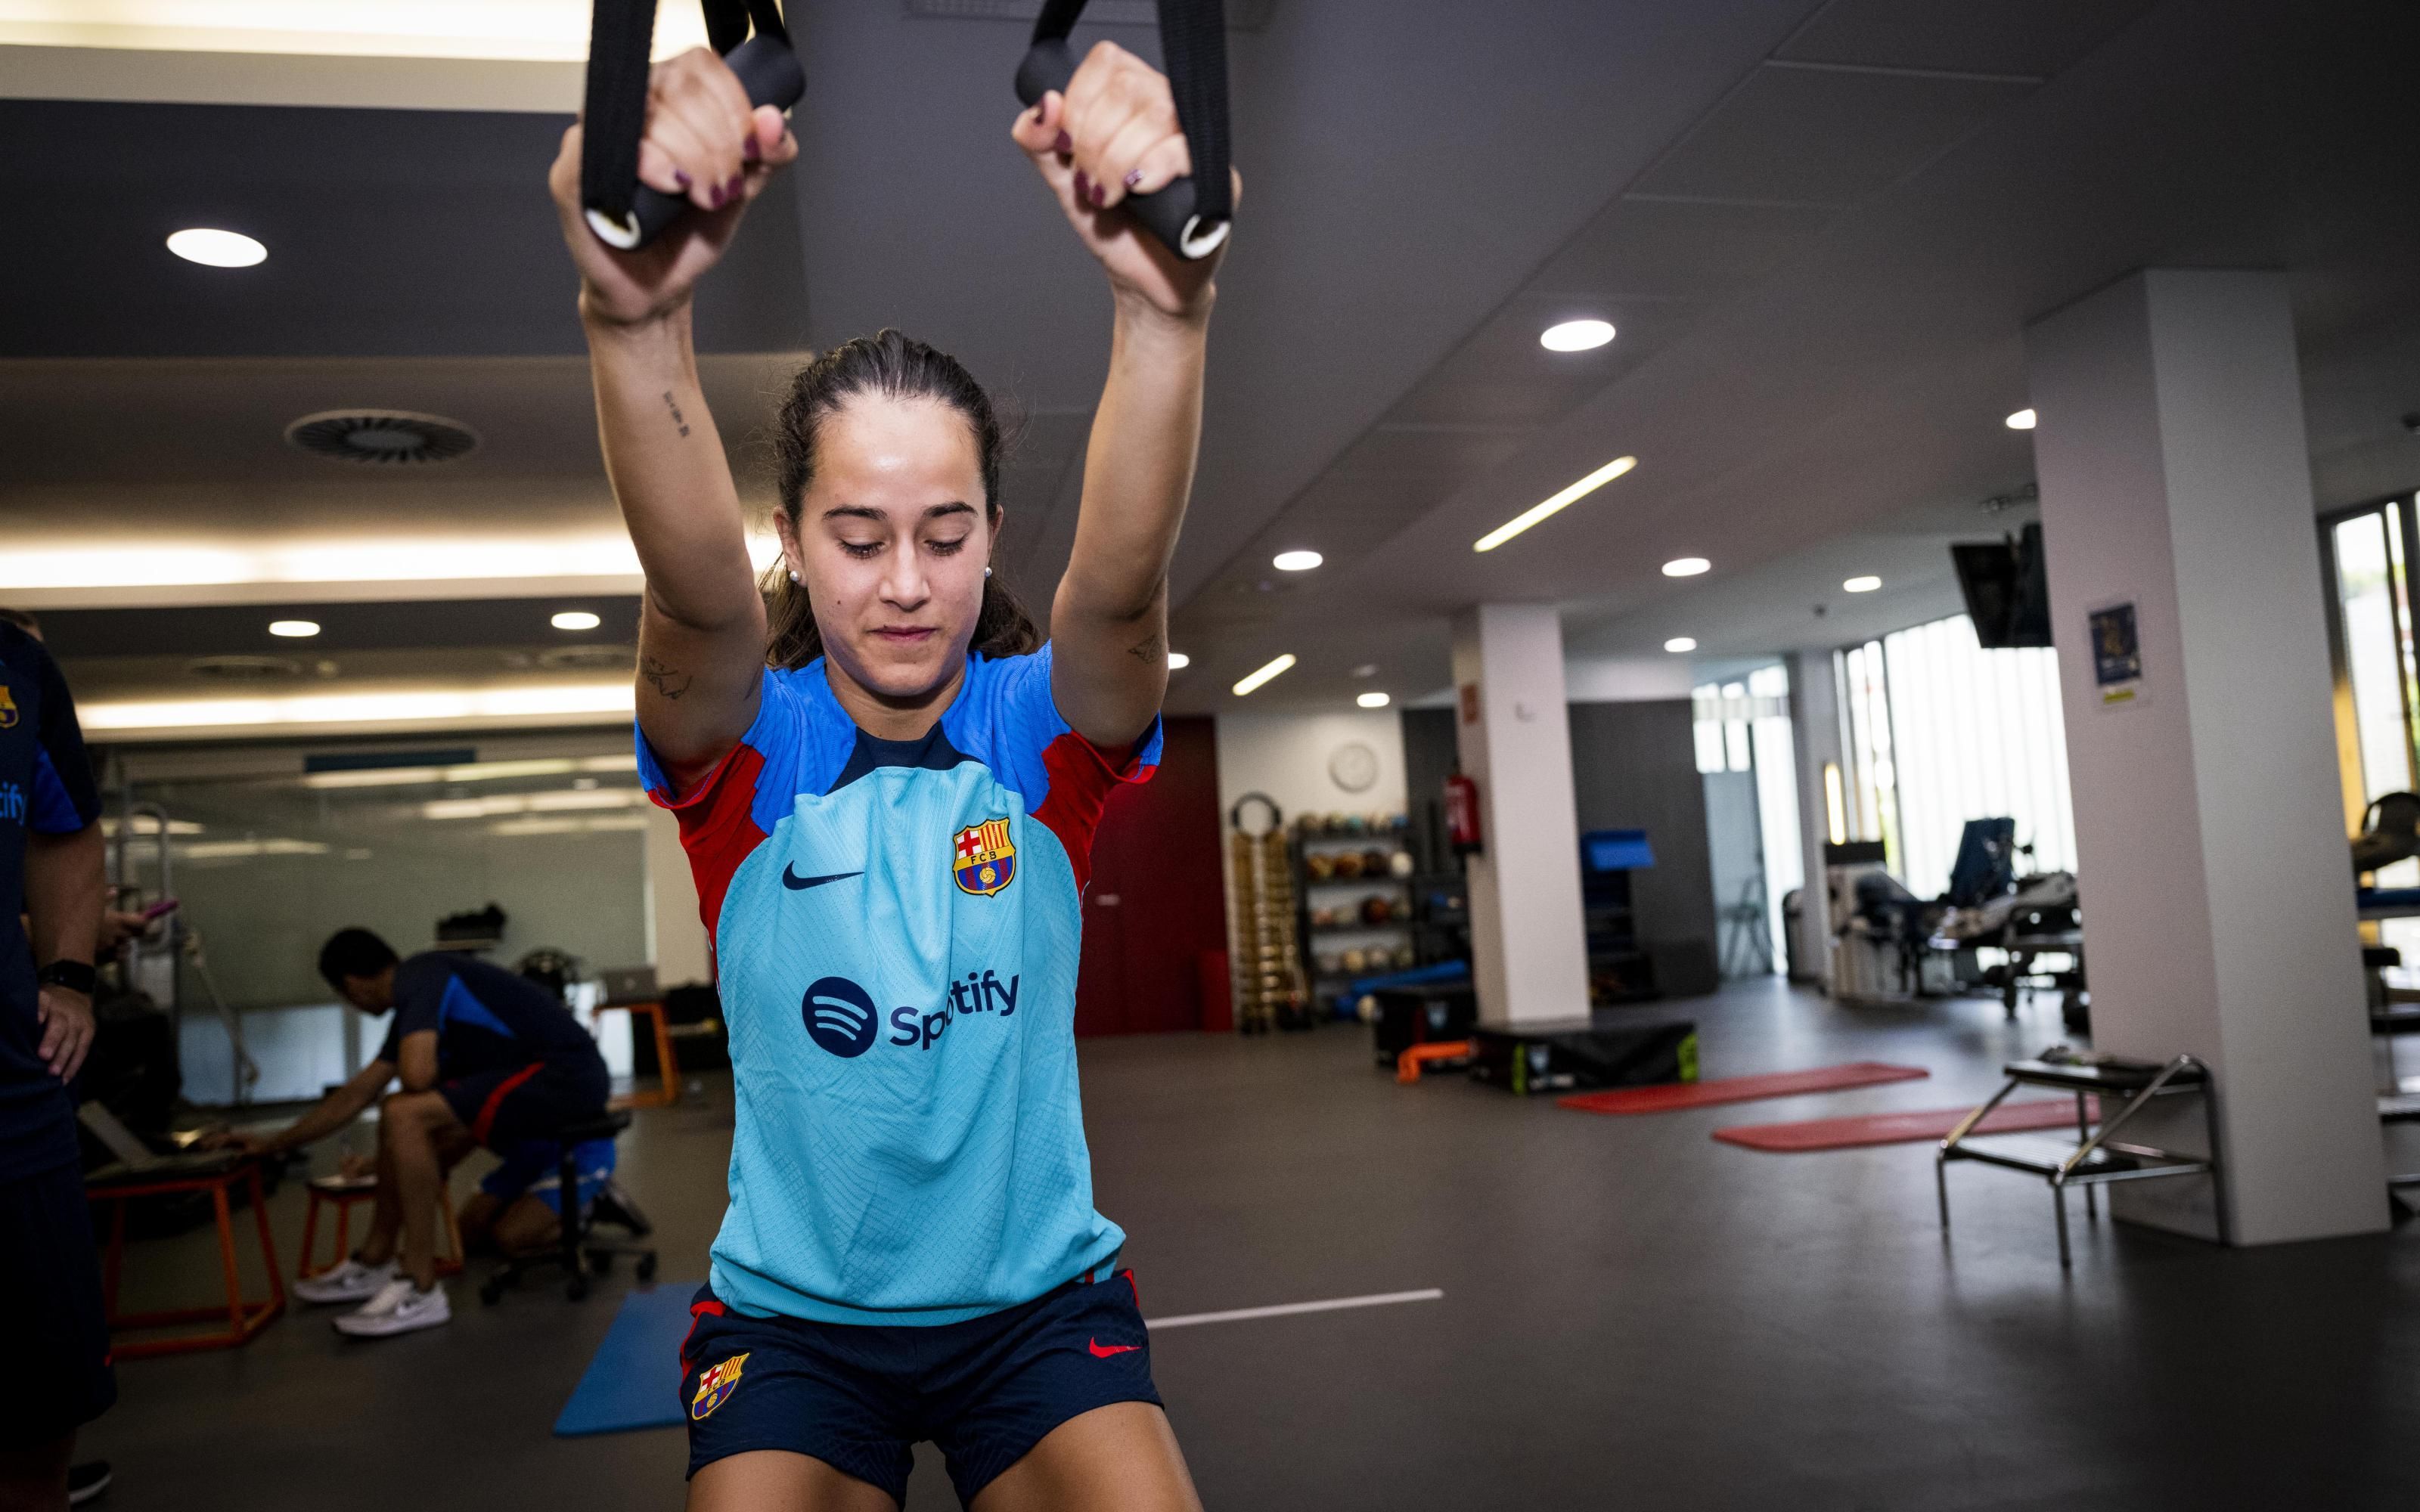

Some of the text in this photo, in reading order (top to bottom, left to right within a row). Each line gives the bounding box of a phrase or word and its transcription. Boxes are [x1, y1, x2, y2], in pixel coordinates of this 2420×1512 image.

[0, 781, 27, 826] ify
[970, 850, 997, 864] FCB
[889, 969, 1019, 1051] Spotify
[707, 1378, 725, 1395] FCB
